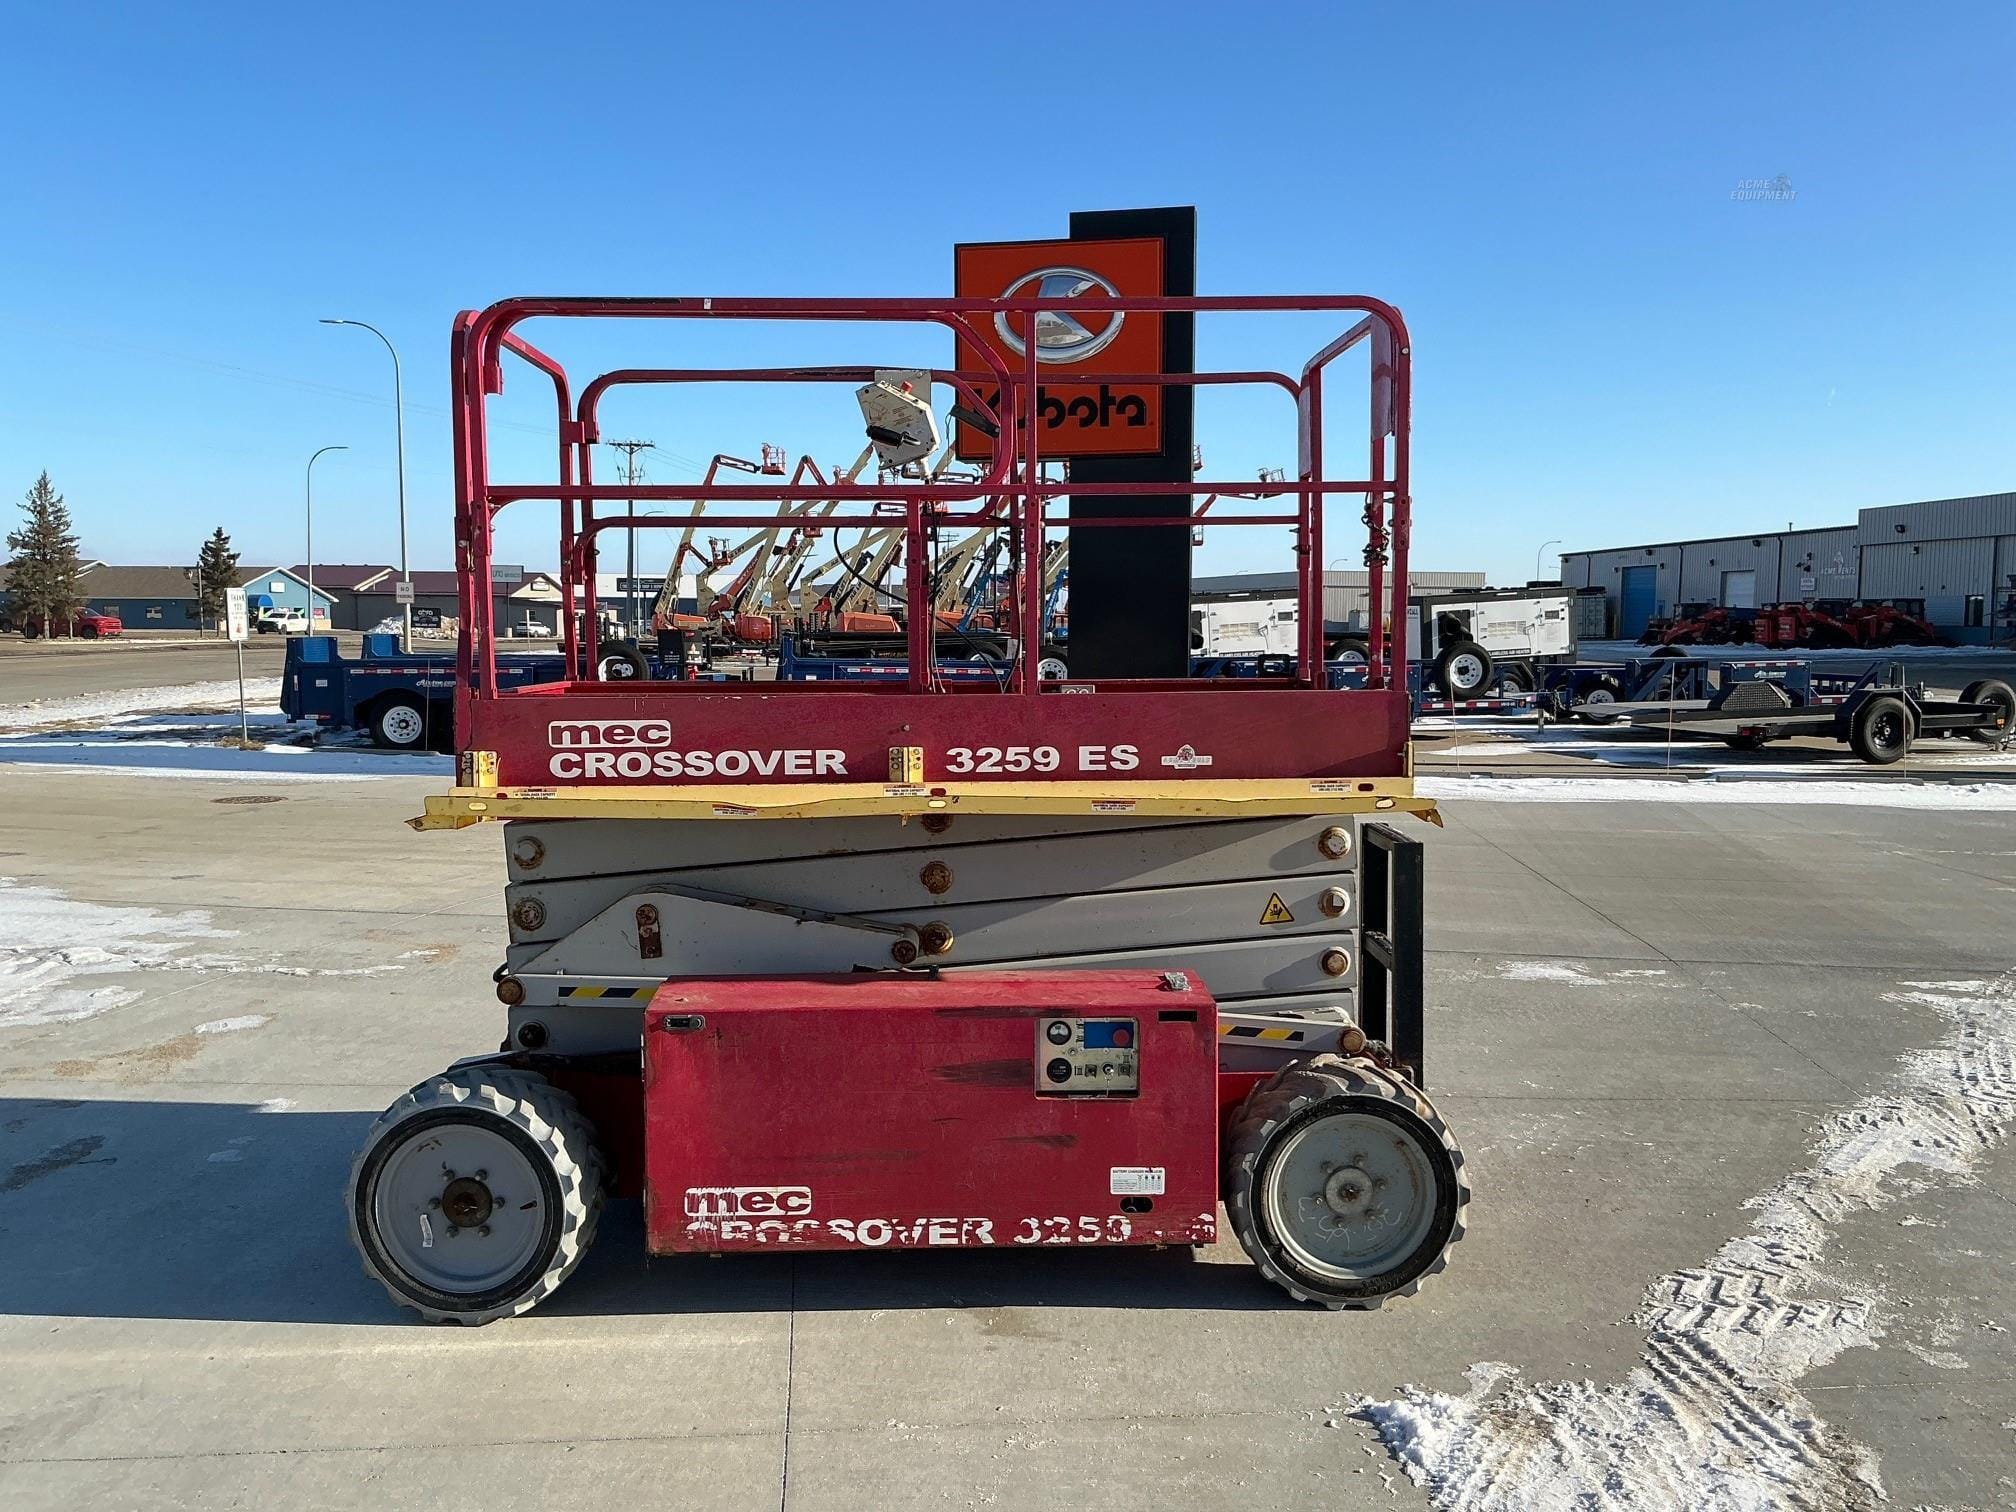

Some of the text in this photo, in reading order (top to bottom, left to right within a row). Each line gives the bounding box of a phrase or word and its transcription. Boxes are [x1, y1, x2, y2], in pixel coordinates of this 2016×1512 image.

[972, 383, 1147, 430] bota
[550, 721, 671, 748] mec
[549, 749, 848, 779] CROSSOVER
[945, 744, 1140, 774] 3259 ES
[686, 1187, 811, 1215] mec
